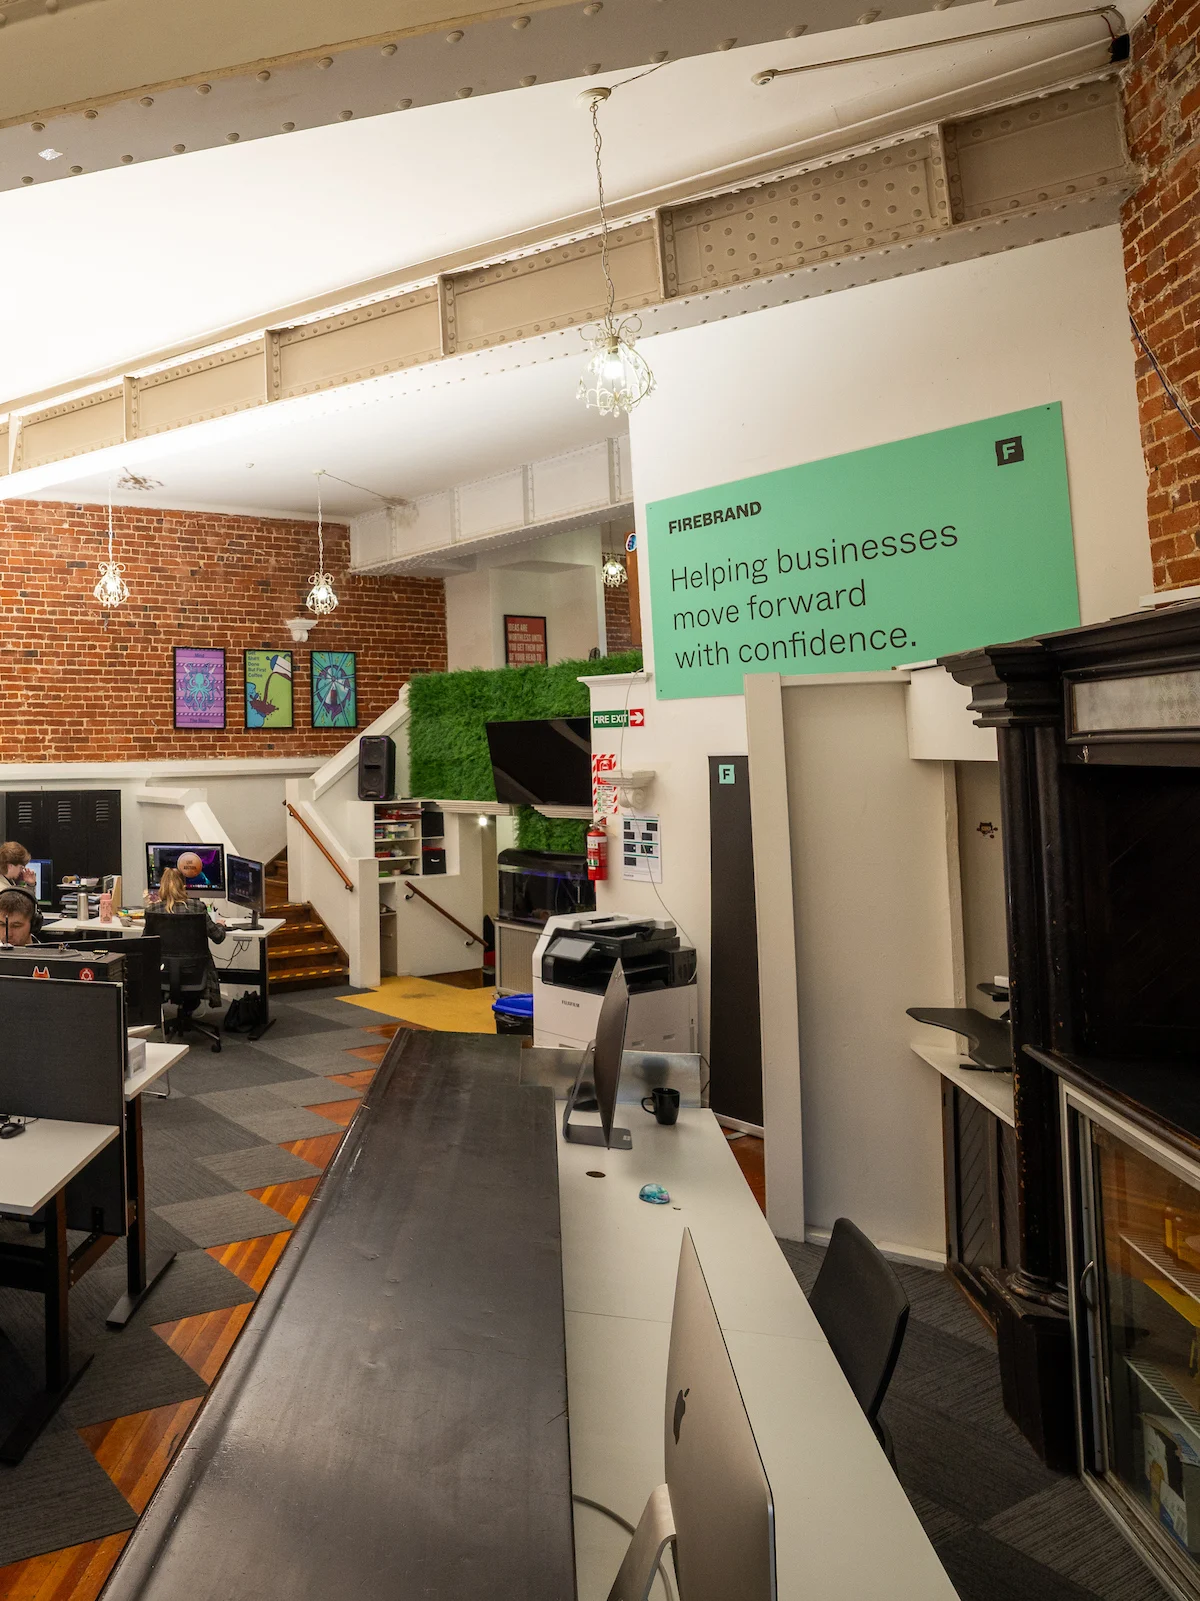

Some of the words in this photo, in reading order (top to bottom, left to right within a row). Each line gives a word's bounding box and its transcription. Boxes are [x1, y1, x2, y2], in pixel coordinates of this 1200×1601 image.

[668, 501, 762, 535] FIREBRAND
[671, 557, 768, 592] Helping
[777, 525, 958, 574] businesses
[673, 604, 740, 631] move
[746, 578, 867, 621] forward
[675, 640, 730, 669] with
[738, 628, 917, 663] confidence.
[593, 715, 610, 724] FIRE
[610, 714, 628, 724] EXIT
